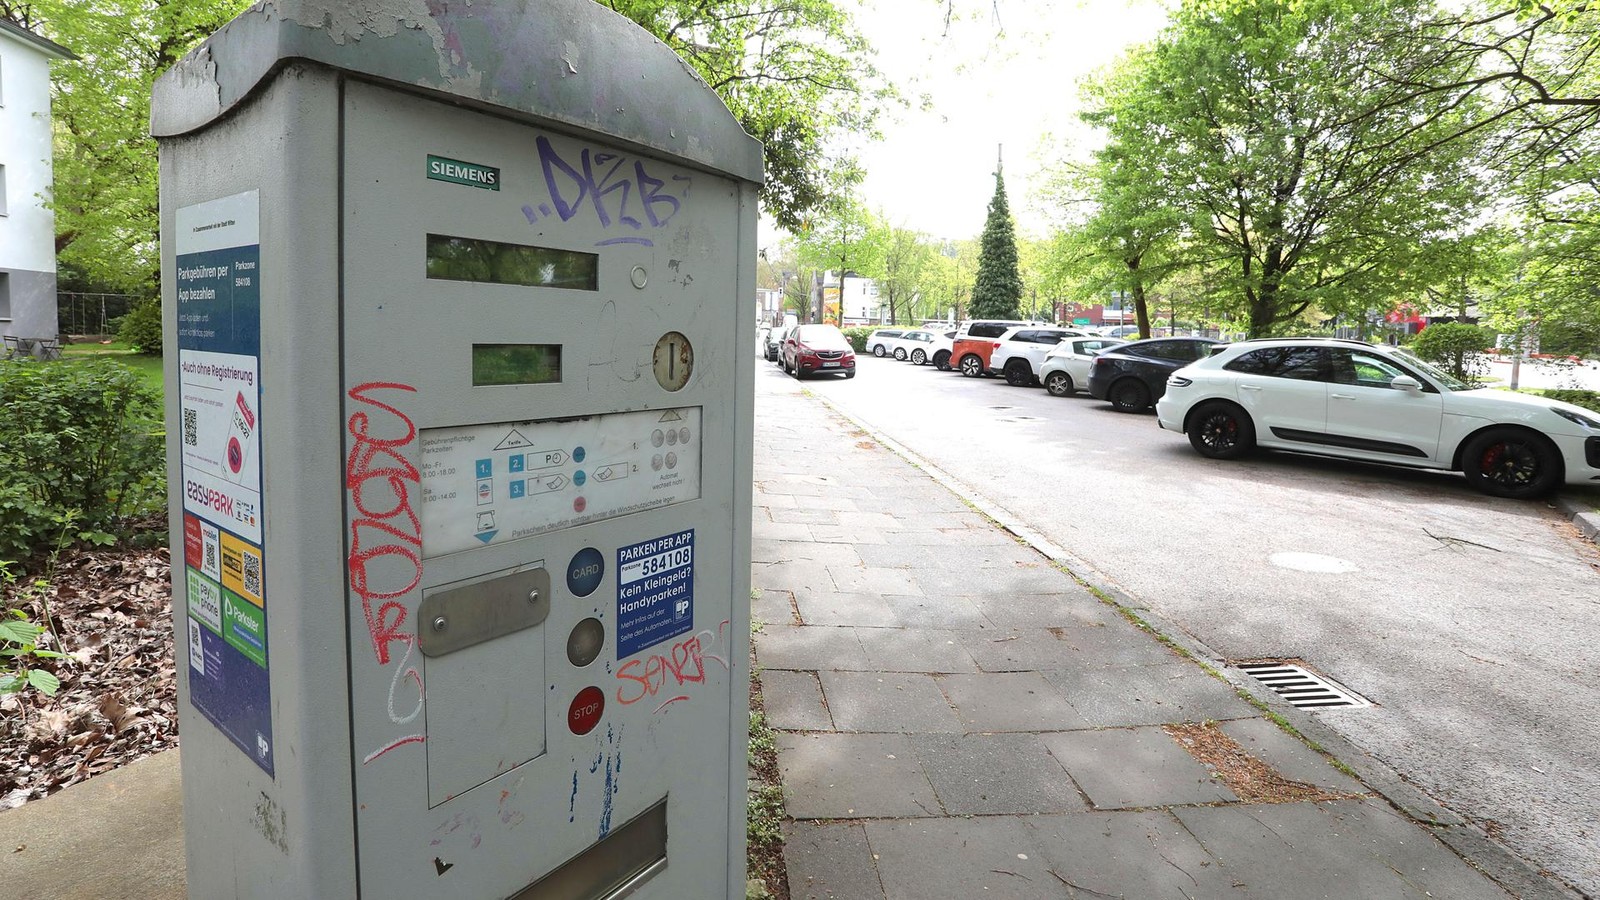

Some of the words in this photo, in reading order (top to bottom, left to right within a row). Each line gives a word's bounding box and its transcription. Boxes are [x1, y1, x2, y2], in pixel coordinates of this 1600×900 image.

[431, 160, 496, 185] SIEMENS
[178, 266, 216, 281] Parkgebühren
[217, 265, 228, 279] per
[235, 261, 255, 270] Parkzone
[178, 288, 189, 303] App
[190, 287, 216, 300] bezahlen
[197, 364, 212, 376] ohne
[212, 365, 253, 386] Registrierung
[422, 445, 453, 455] Parkzeiten
[512, 524, 548, 538] Parkschein
[549, 519, 570, 530] deutlich
[620, 542, 657, 562] PARKEN
[658, 537, 674, 551] PER
[675, 532, 692, 547] APP
[621, 562, 641, 572] Parkzone
[642, 548, 690, 576] 584108
[572, 564, 599, 580] CARD
[620, 584, 642, 600] Kein
[644, 566, 692, 592] Kleingeld?
[201, 598, 218, 617] phone
[620, 582, 687, 615] Handyparken!
[233, 606, 259, 633] Parkster
[621, 620, 634, 630] Mehr
[635, 615, 647, 625] Infos
[647, 612, 656, 620] auf
[656, 608, 665, 616] der
[620, 632, 633, 642] Seite
[634, 629, 644, 637] des
[574, 703, 599, 720] STOP
